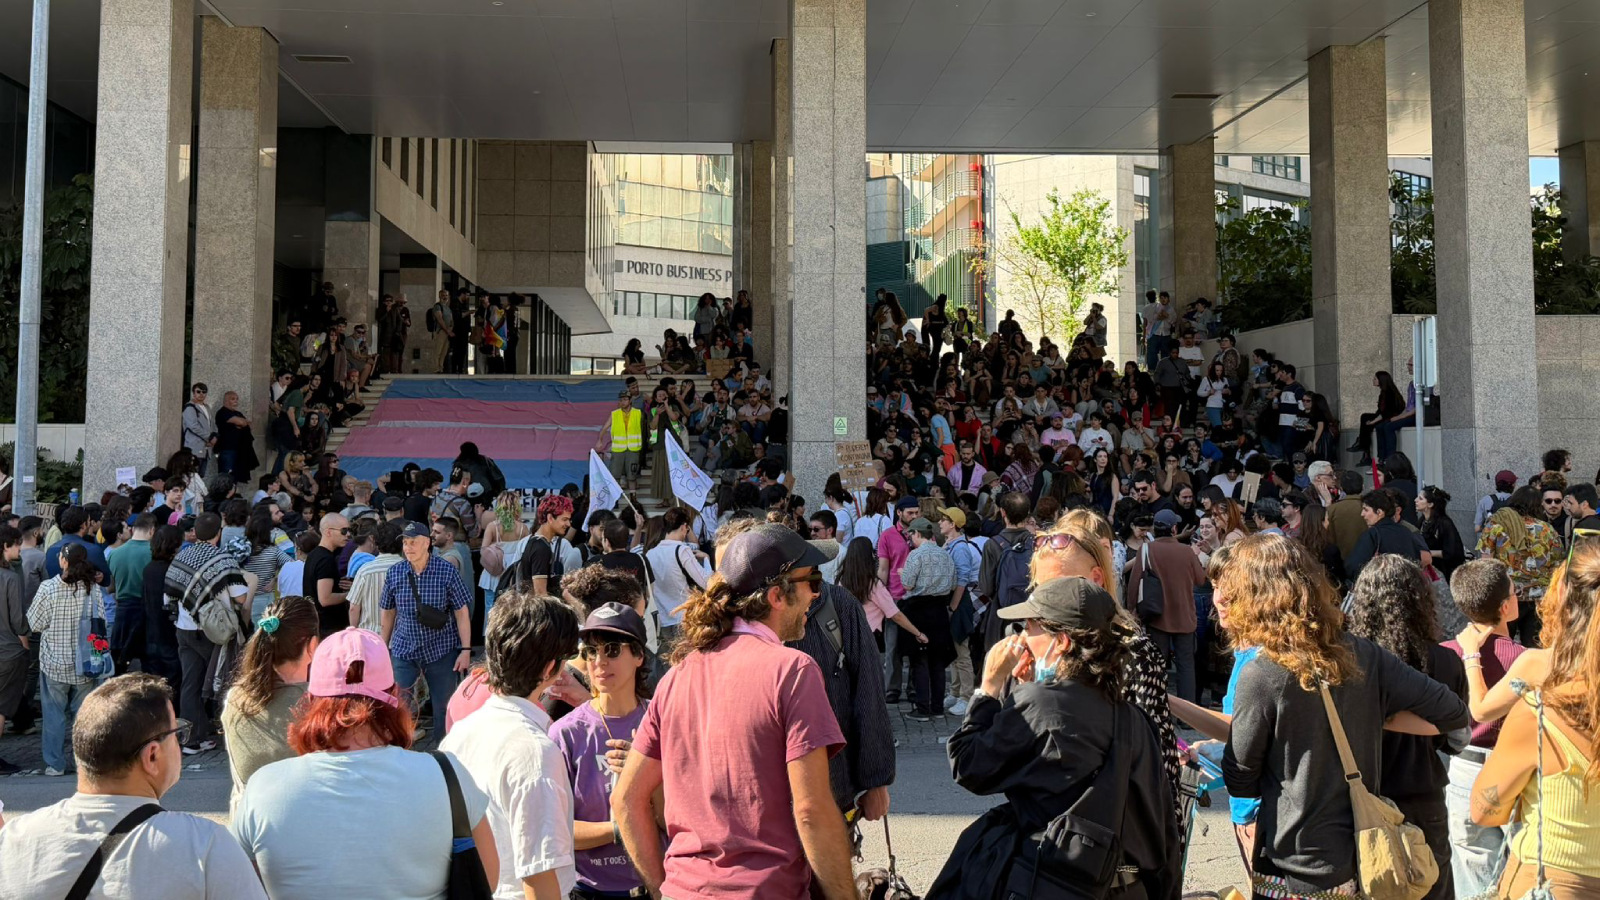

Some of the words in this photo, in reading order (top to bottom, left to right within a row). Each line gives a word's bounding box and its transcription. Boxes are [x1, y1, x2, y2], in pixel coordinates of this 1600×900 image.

[627, 260, 663, 276] PORTO
[666, 264, 722, 281] BUSINESS
[603, 855, 628, 866] TODES
